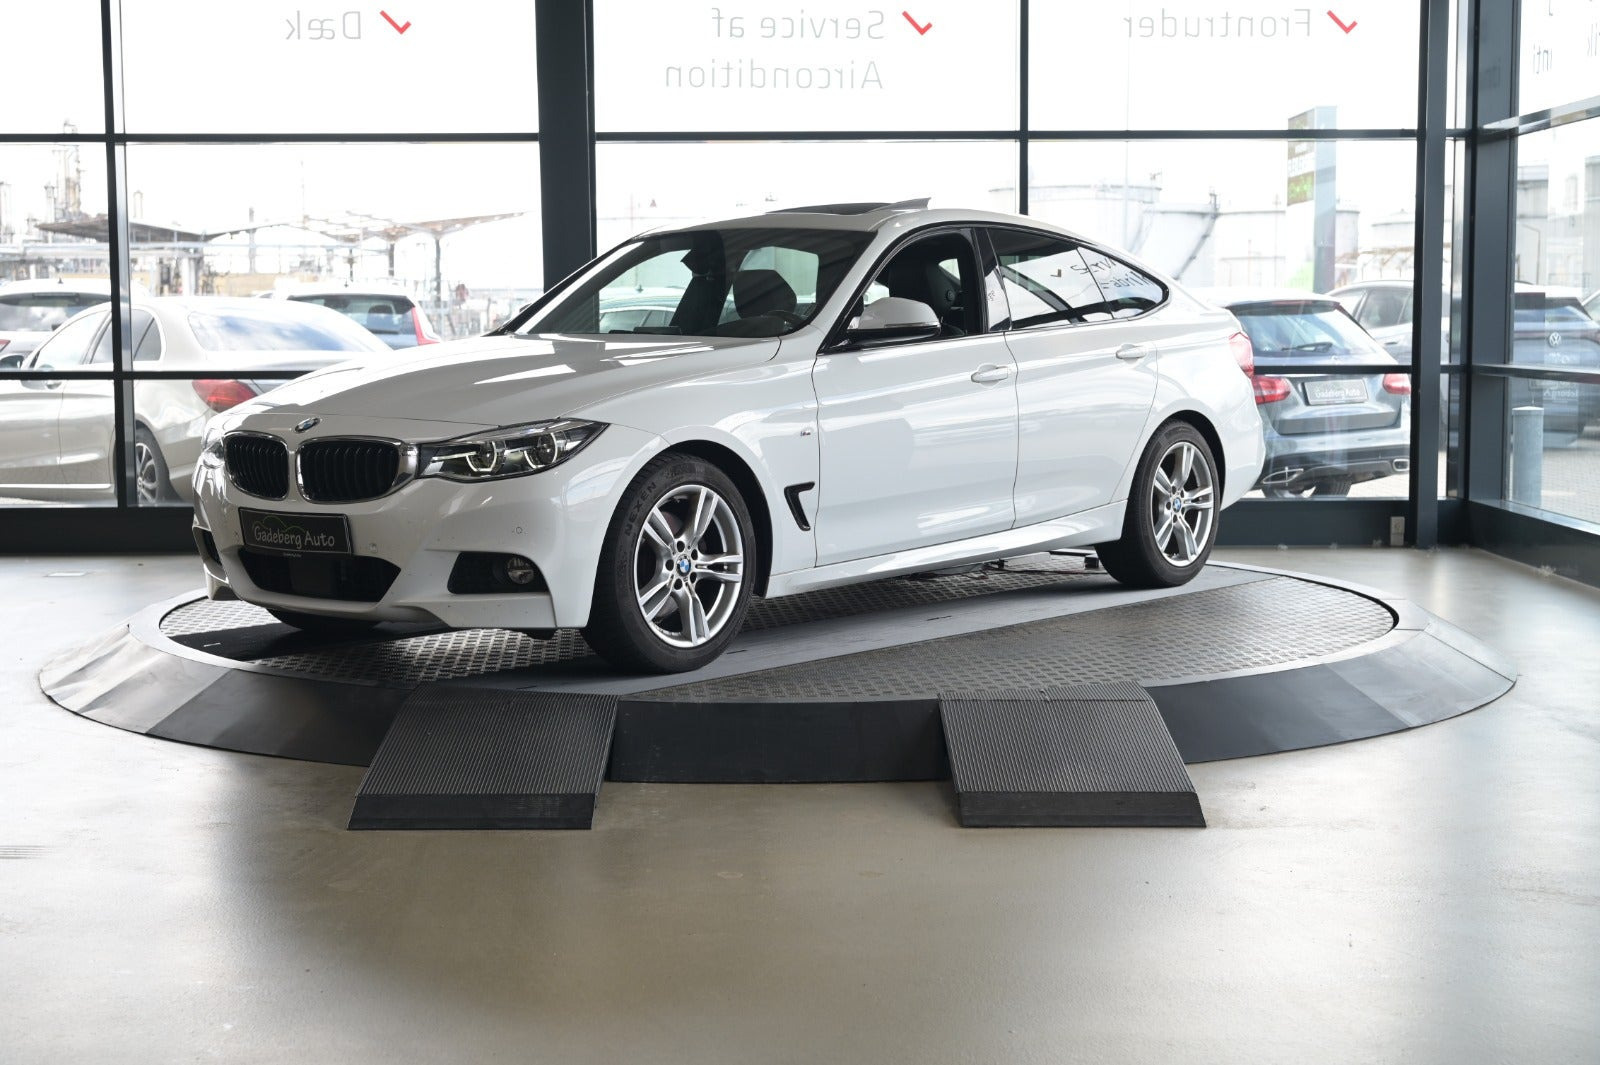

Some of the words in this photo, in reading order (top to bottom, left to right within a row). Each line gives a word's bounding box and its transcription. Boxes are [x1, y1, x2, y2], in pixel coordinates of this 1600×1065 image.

[624, 481, 656, 536] NEXEN
[254, 525, 302, 549] Gadeberg
[304, 530, 335, 548] Auto
